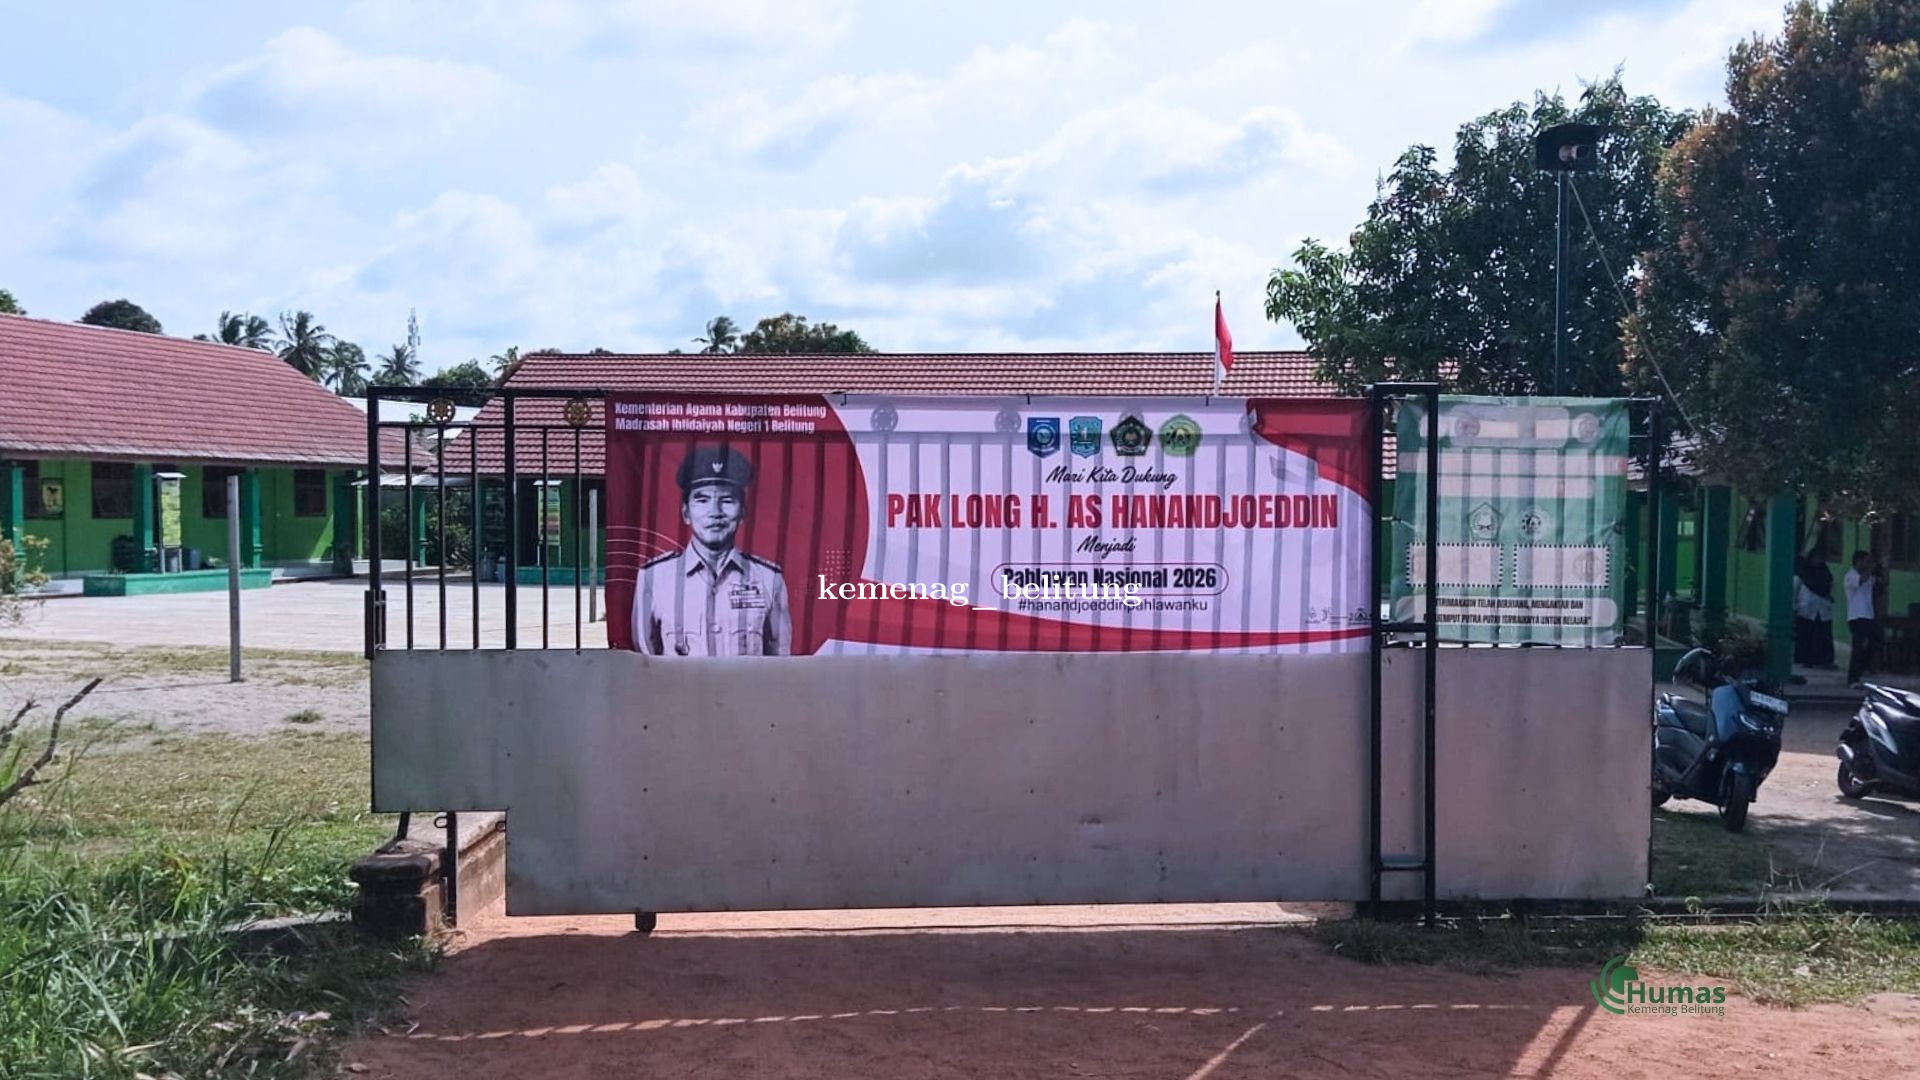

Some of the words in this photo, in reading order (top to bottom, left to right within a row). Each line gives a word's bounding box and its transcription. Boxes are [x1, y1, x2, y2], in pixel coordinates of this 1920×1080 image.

[615, 402, 683, 415] Kementerian
[686, 403, 722, 417] Agama
[725, 403, 781, 418] Kabupaten
[783, 404, 827, 418] Belitung
[615, 418, 669, 431] Madrasah
[727, 419, 761, 434] Negeri
[764, 420, 769, 432] 1
[771, 420, 815, 434] Belitung
[1046, 465, 1085, 483] Mari
[1086, 466, 1118, 483] Kita
[1121, 466, 1178, 490] Dukung
[887, 493, 942, 528] PAK
[951, 494, 1021, 528] LONG
[1031, 494, 1057, 528] H.
[1067, 494, 1103, 529] AS
[1112, 494, 1338, 529] HANANDJOEDDIN
[1077, 535, 1137, 559] Menjadi
[1093, 567, 1168, 588] Nasional
[1173, 567, 1217, 588] 2026
